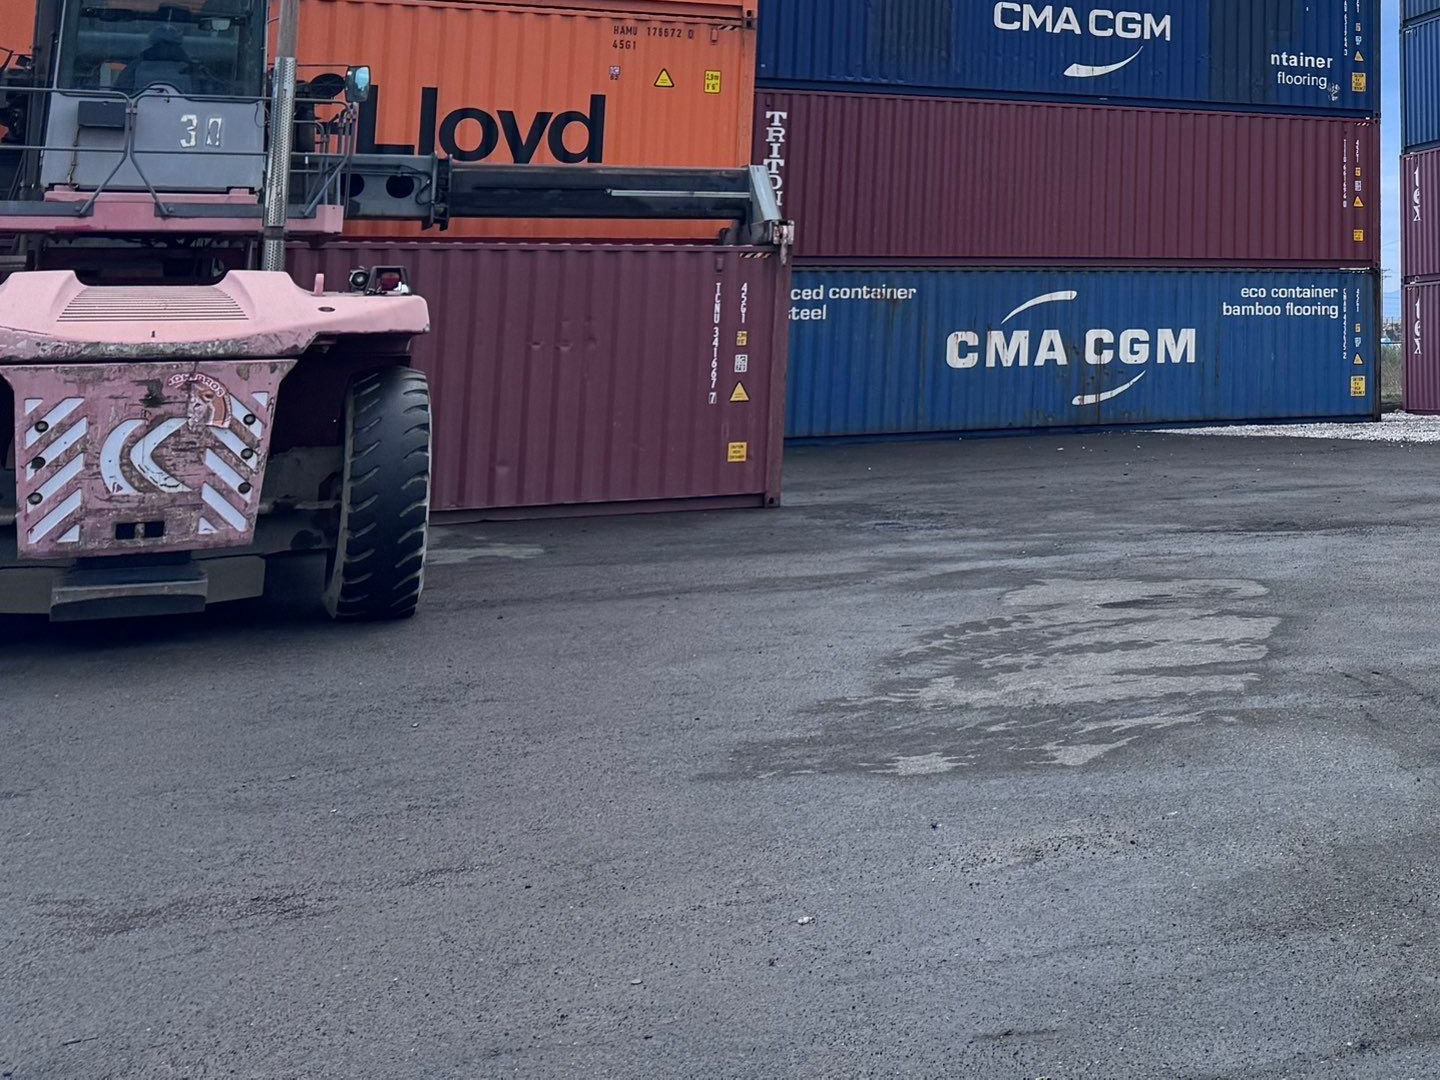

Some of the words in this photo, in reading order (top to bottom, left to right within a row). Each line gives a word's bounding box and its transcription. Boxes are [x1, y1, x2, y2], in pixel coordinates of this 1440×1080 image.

[994, 1, 1082, 35] CMA
[1089, 9, 1171, 41] CGM
[613, 25, 638, 36] HAMU
[612, 40, 637, 50] 45G1
[1278, 71, 1327, 89] flooring
[828, 284, 917, 299] container
[1240, 287, 1267, 298] eco
[1271, 285, 1339, 298] container
[713, 282, 721, 324] TCNU
[1222, 302, 1282, 316] bamboo
[1286, 302, 1339, 319] flooring
[946, 329, 1068, 369] CMA
[1085, 328, 1196, 365] CGM
[711, 327, 719, 389] 341667
